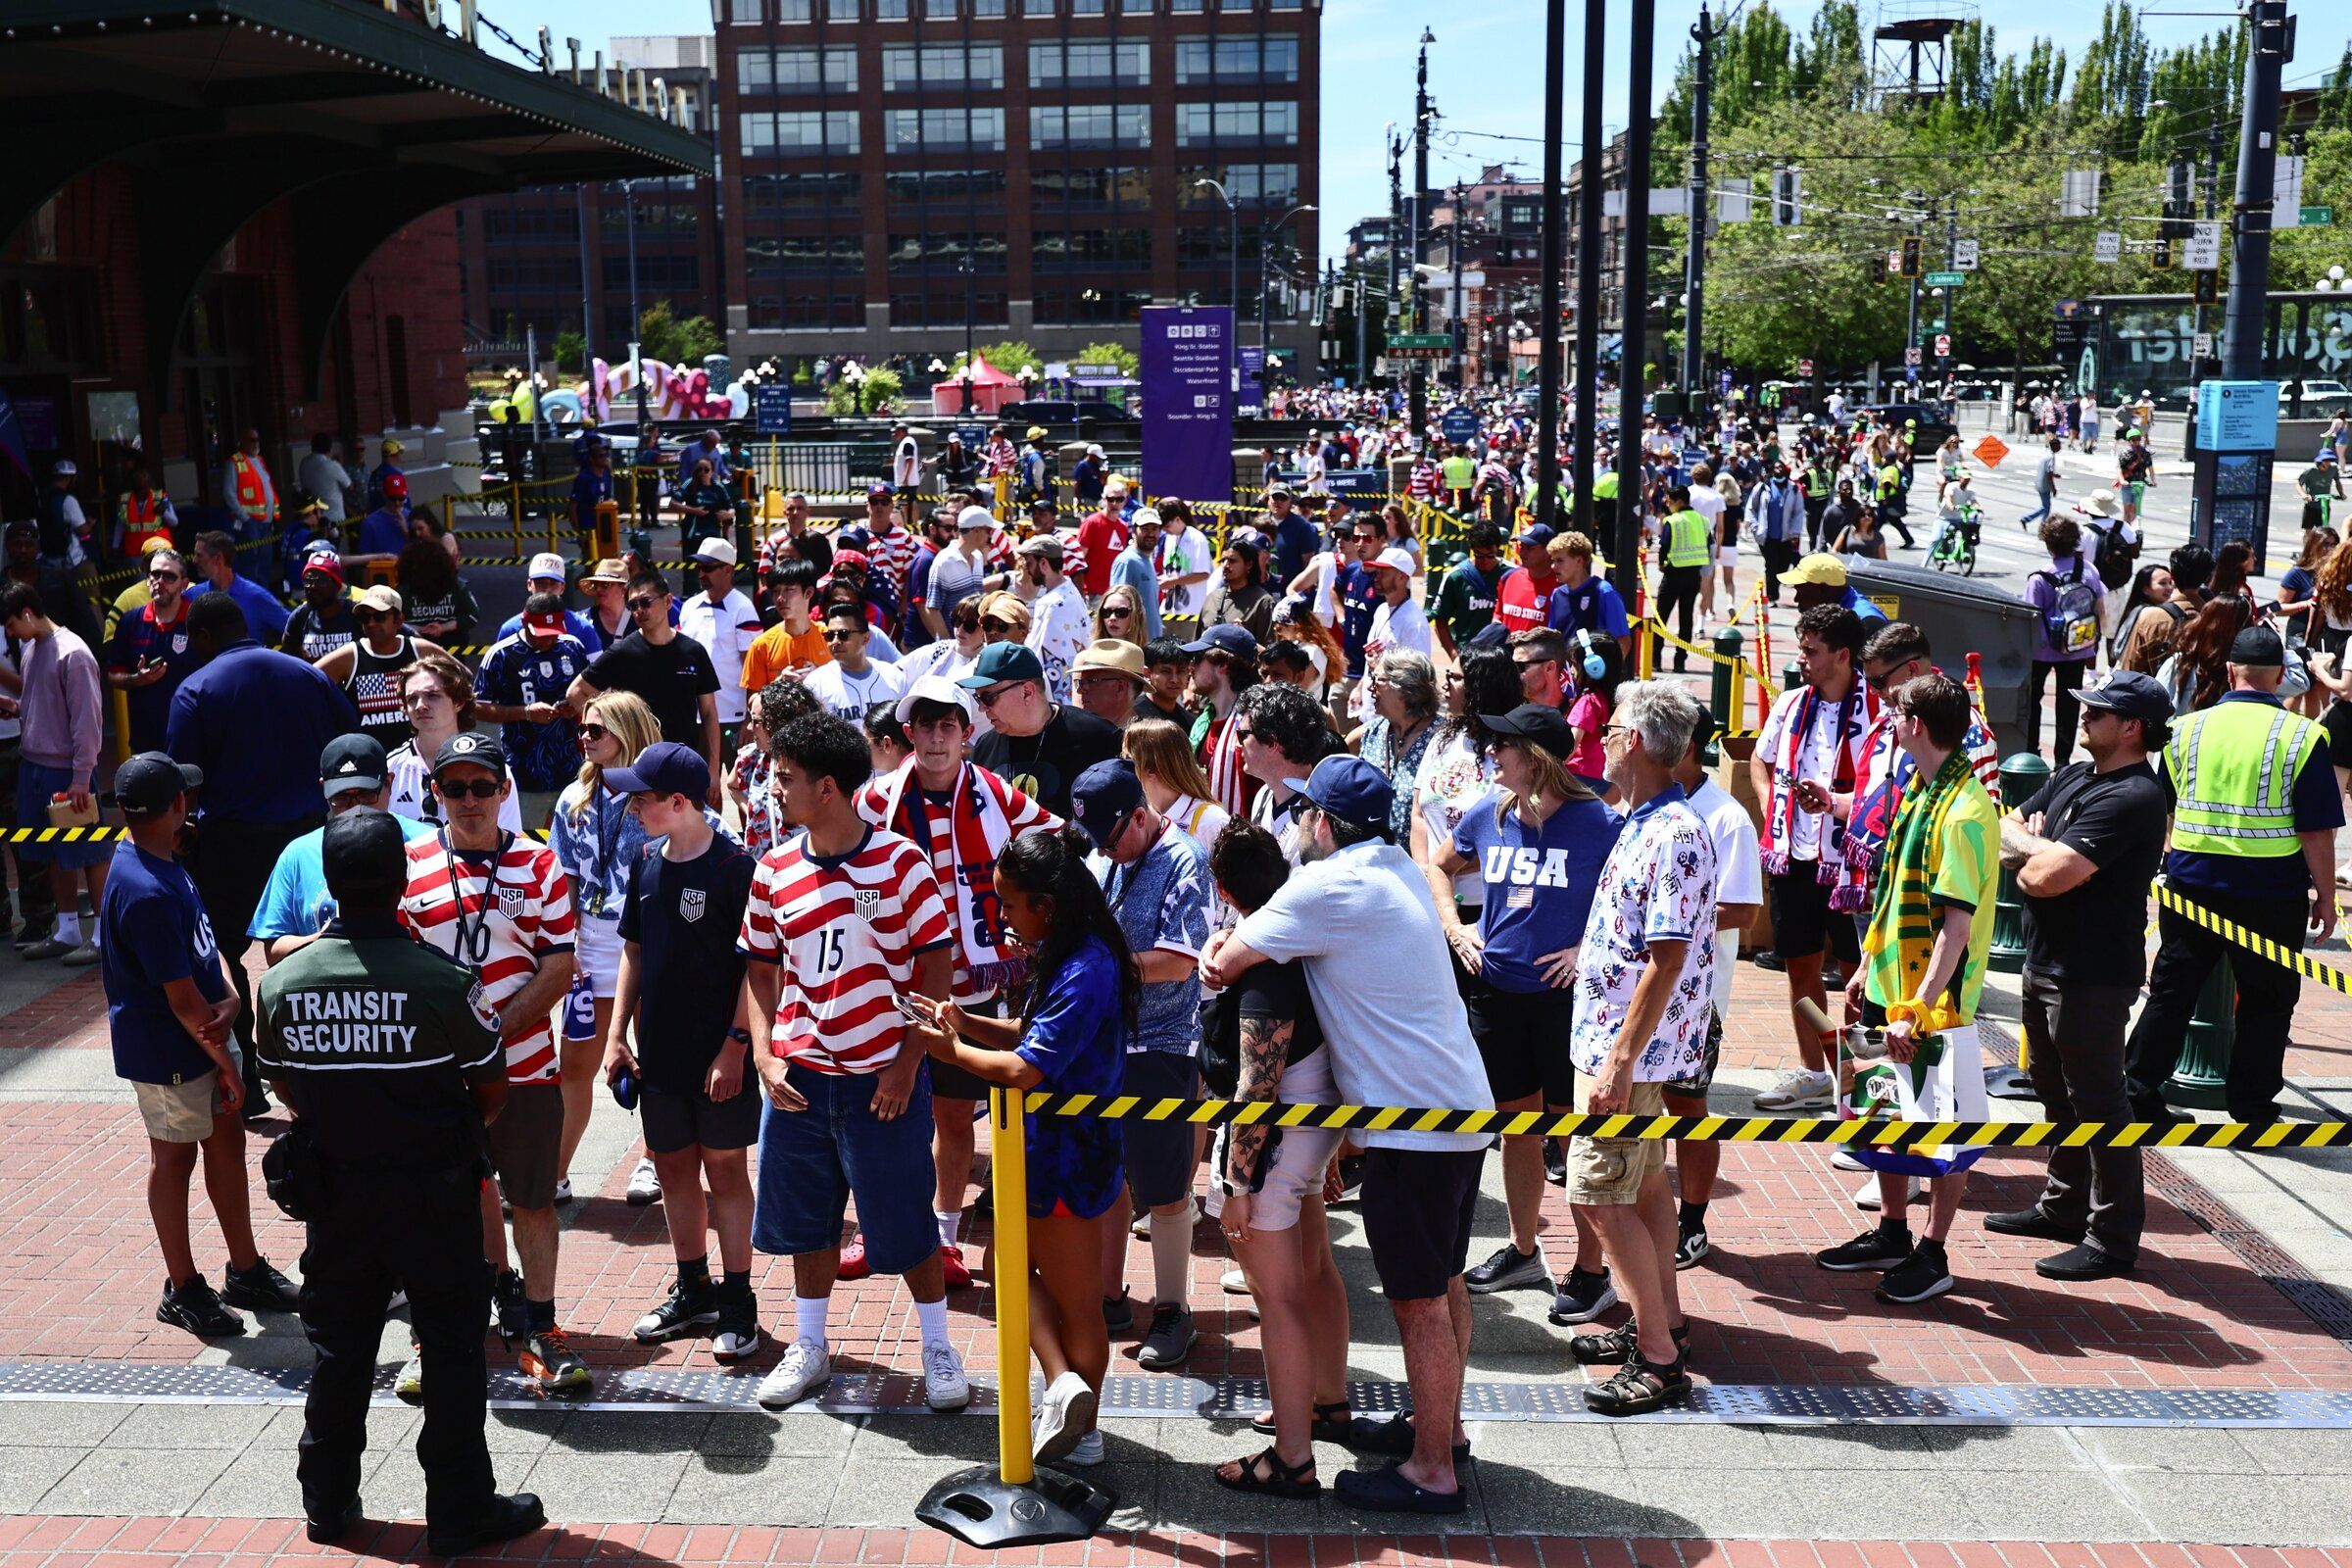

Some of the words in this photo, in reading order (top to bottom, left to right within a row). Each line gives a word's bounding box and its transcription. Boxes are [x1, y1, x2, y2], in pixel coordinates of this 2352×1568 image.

[2195, 226, 2212, 236] NO
[538, 559, 560, 568] 1776
[412, 605, 456, 617] SECURITY
[325, 632, 353, 644] STATES
[520, 681, 536, 705] 6
[361, 712, 410, 726] AMER
[1484, 846, 1569, 889] USA
[501, 888, 523, 903] USA
[684, 893, 705, 905] USA
[856, 891, 878, 904] USA
[817, 929, 845, 973] 15
[285, 991, 409, 1022] TRANSIT
[282, 1023, 417, 1054] SECURITY
